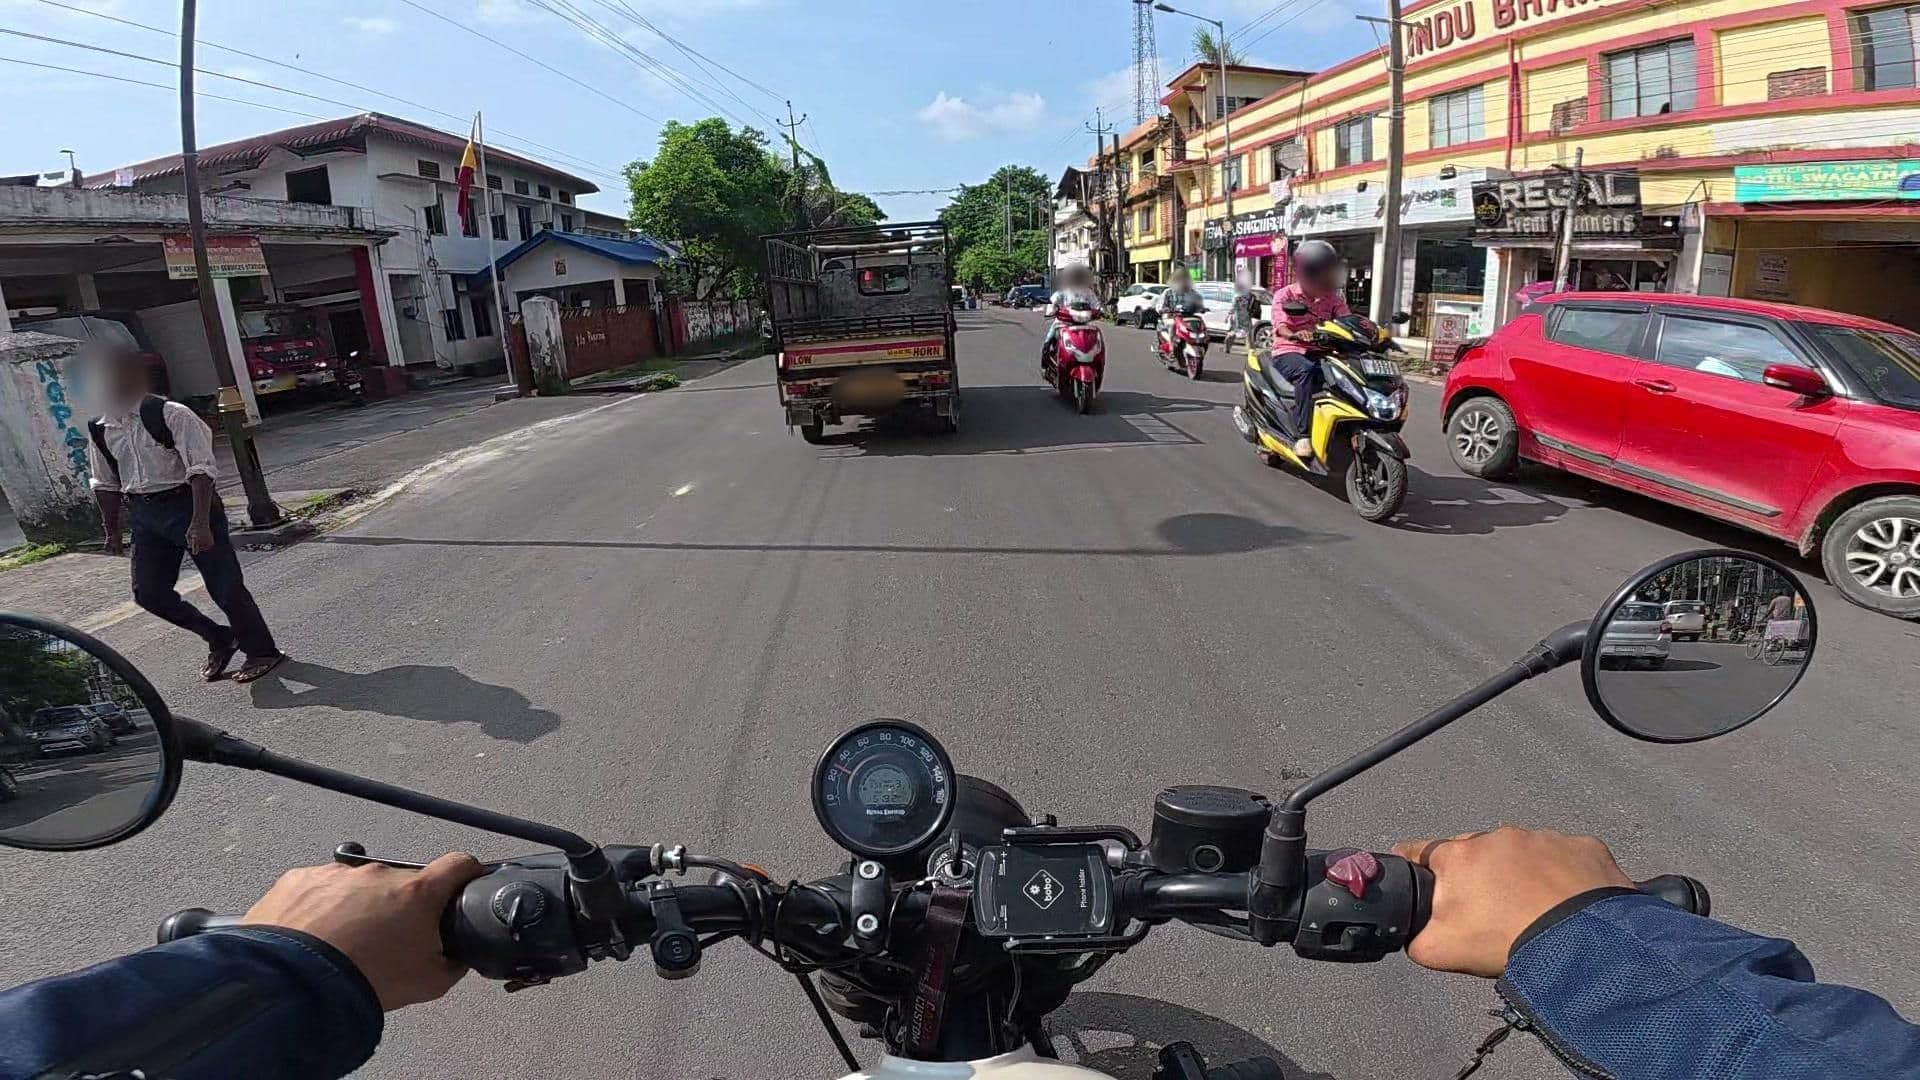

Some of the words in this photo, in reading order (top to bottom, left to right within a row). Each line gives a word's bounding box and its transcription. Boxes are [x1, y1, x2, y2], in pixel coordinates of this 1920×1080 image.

[913, 347, 939, 357] HORN
[879, 732, 892, 741] 80
[899, 735, 916, 748] 100
[919, 746, 934, 763] 120
[1043, 877, 1052, 902] bobo
[1080, 888, 1088, 908] Phone
[912, 995, 926, 1046] CUSTOM
